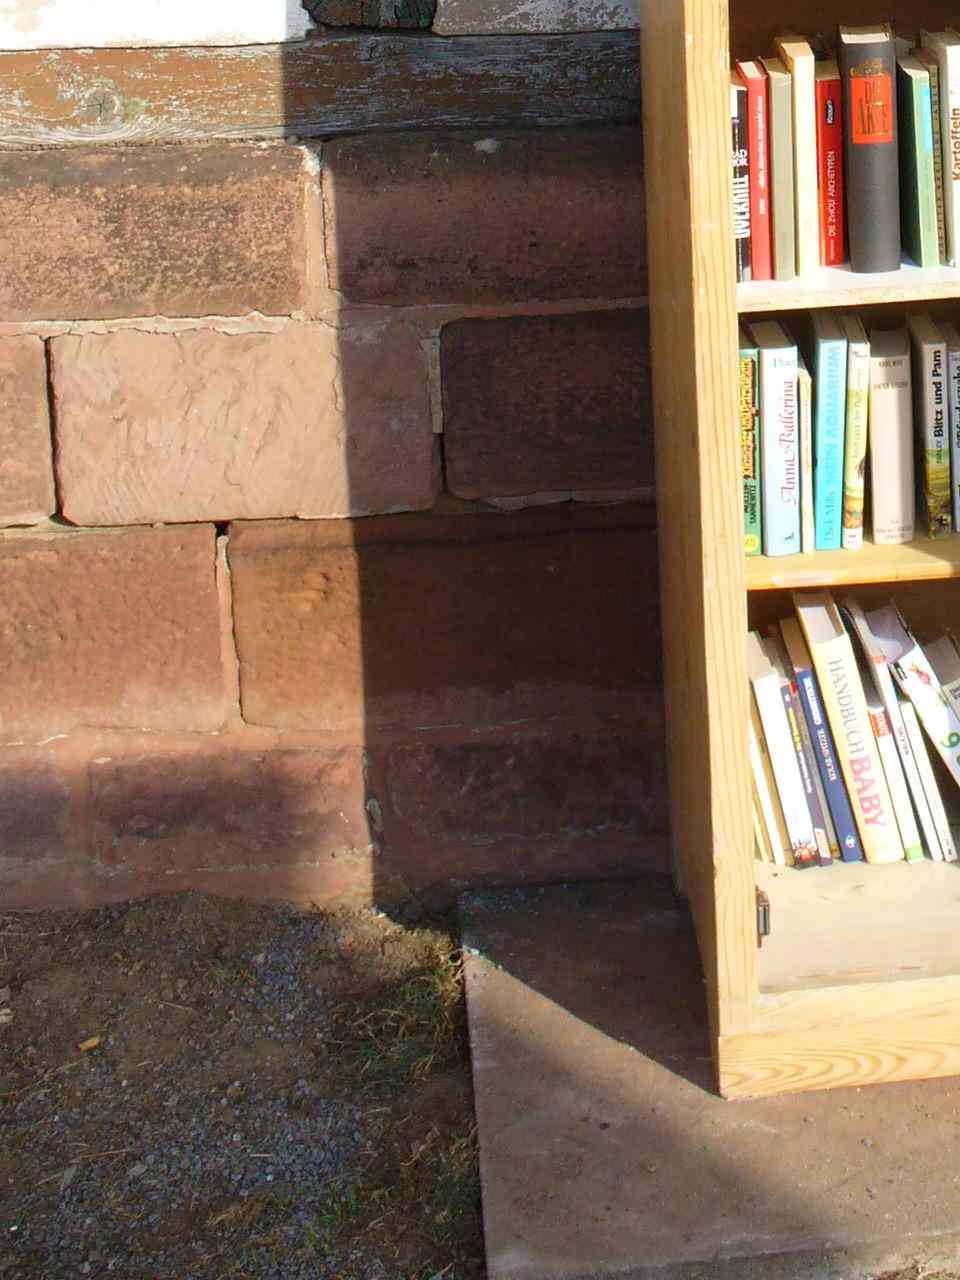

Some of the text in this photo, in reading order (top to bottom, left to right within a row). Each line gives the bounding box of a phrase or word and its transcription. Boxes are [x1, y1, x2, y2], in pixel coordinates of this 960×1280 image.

[931, 349, 943, 377] Pam
[825, 345, 841, 438] AQUARIUM
[932, 382, 943, 405] und
[777, 379, 800, 508] Anna Ballerina
[933, 410, 945, 438] Blitz
[828, 657, 866, 761] HANDBUCH
[942, 731, 960, 749] 6
[849, 752, 887, 828] BABY
